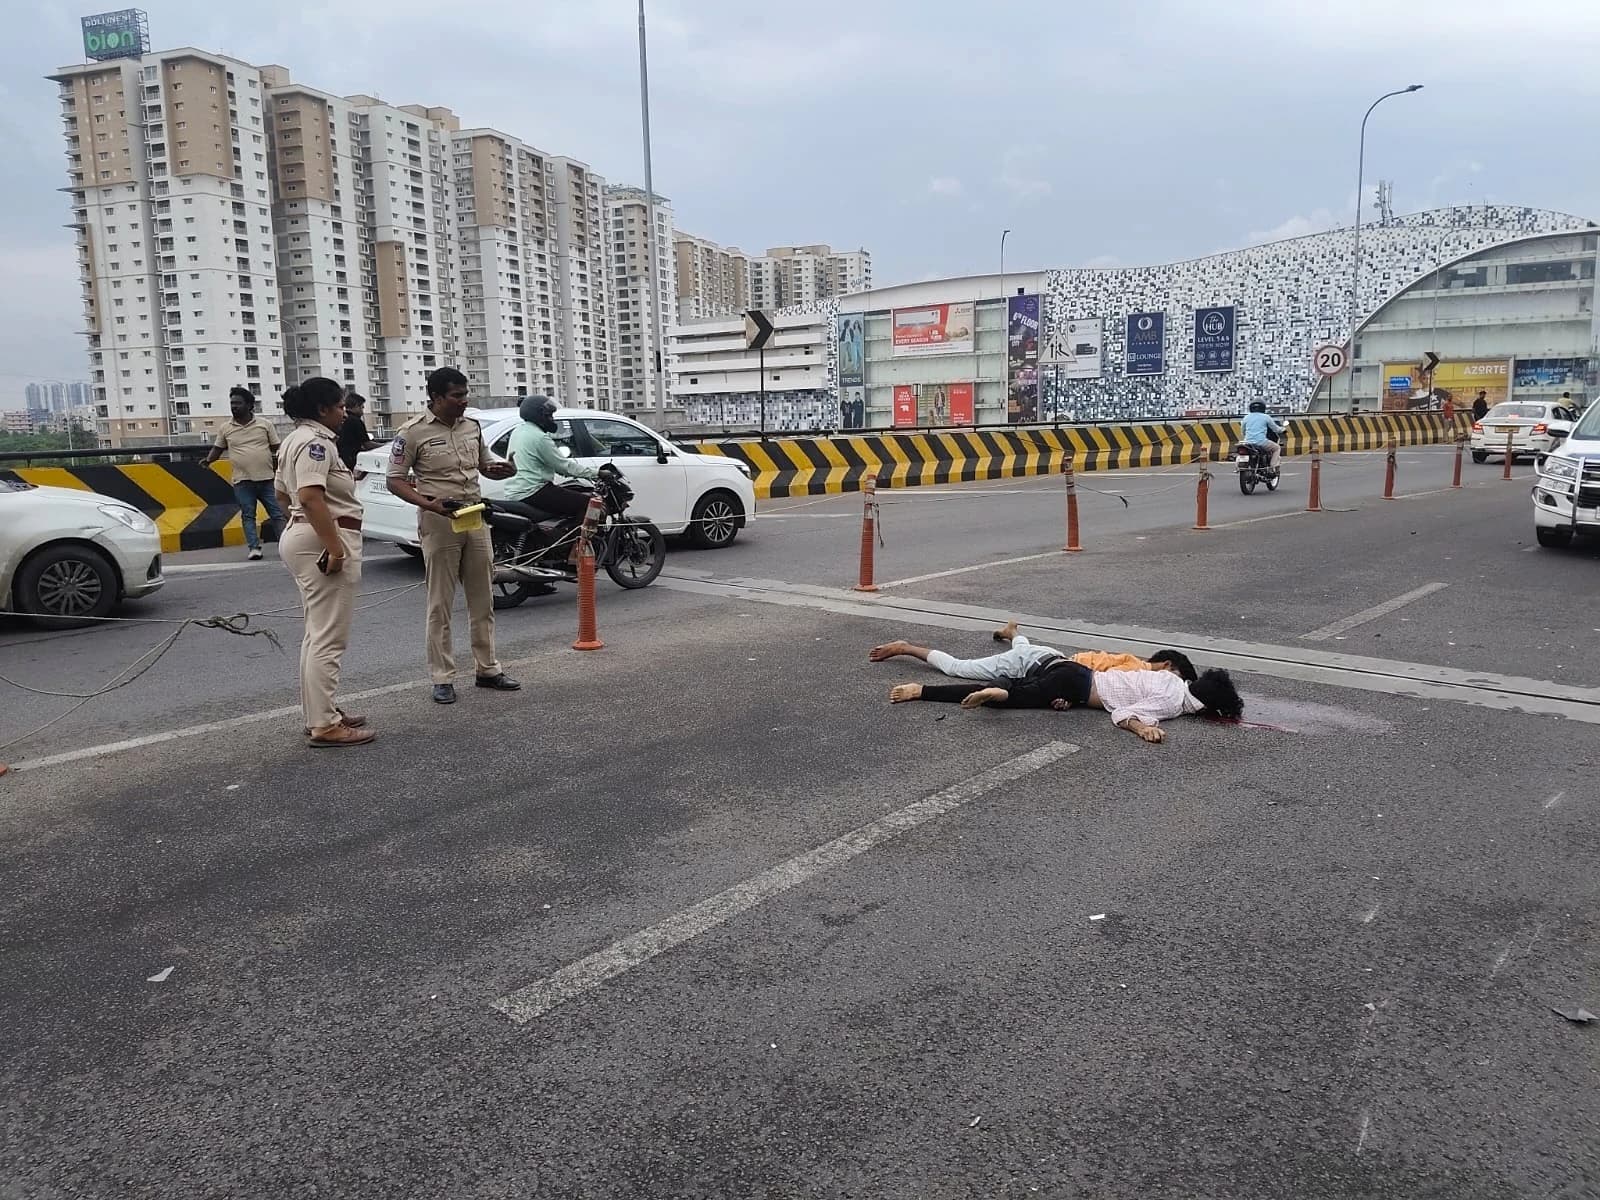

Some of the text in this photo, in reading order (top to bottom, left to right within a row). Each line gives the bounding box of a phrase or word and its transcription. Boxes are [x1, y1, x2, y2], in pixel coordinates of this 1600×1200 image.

[87, 29, 135, 52] bion
[1205, 322, 1223, 331] HUB
[1320, 352, 1341, 368] 20
[1464, 365, 1507, 375] AZORTE
